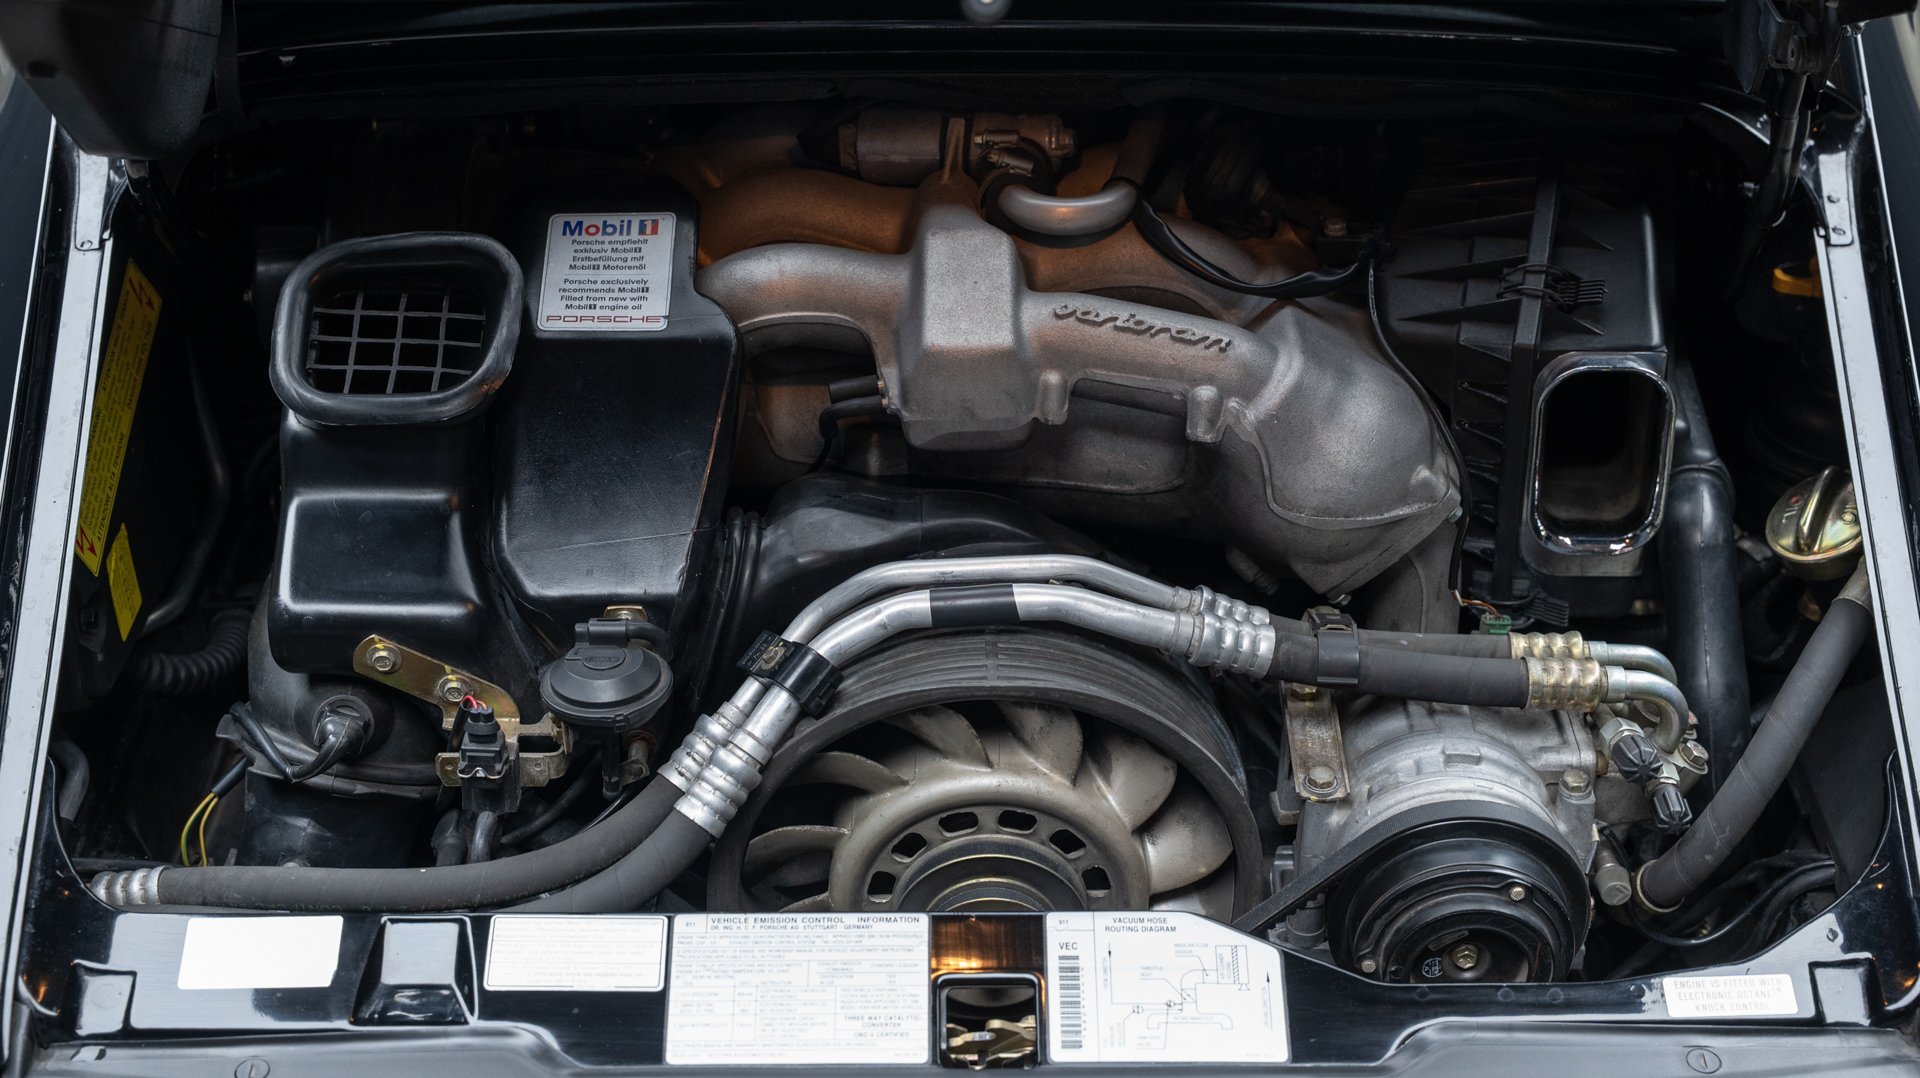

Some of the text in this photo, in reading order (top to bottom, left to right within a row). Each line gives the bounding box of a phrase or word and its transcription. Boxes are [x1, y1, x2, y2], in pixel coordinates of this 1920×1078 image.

[562, 220, 632, 236] Mobil
[1053, 304, 1232, 354] varioram
[1058, 942, 1078, 950] VEC
[1674, 977, 1781, 990] ENGINE IS FITTED WITH
[1678, 991, 1734, 1001] ELECTRONIC
[1695, 1002, 1770, 1012] KNOCK CONTROL
